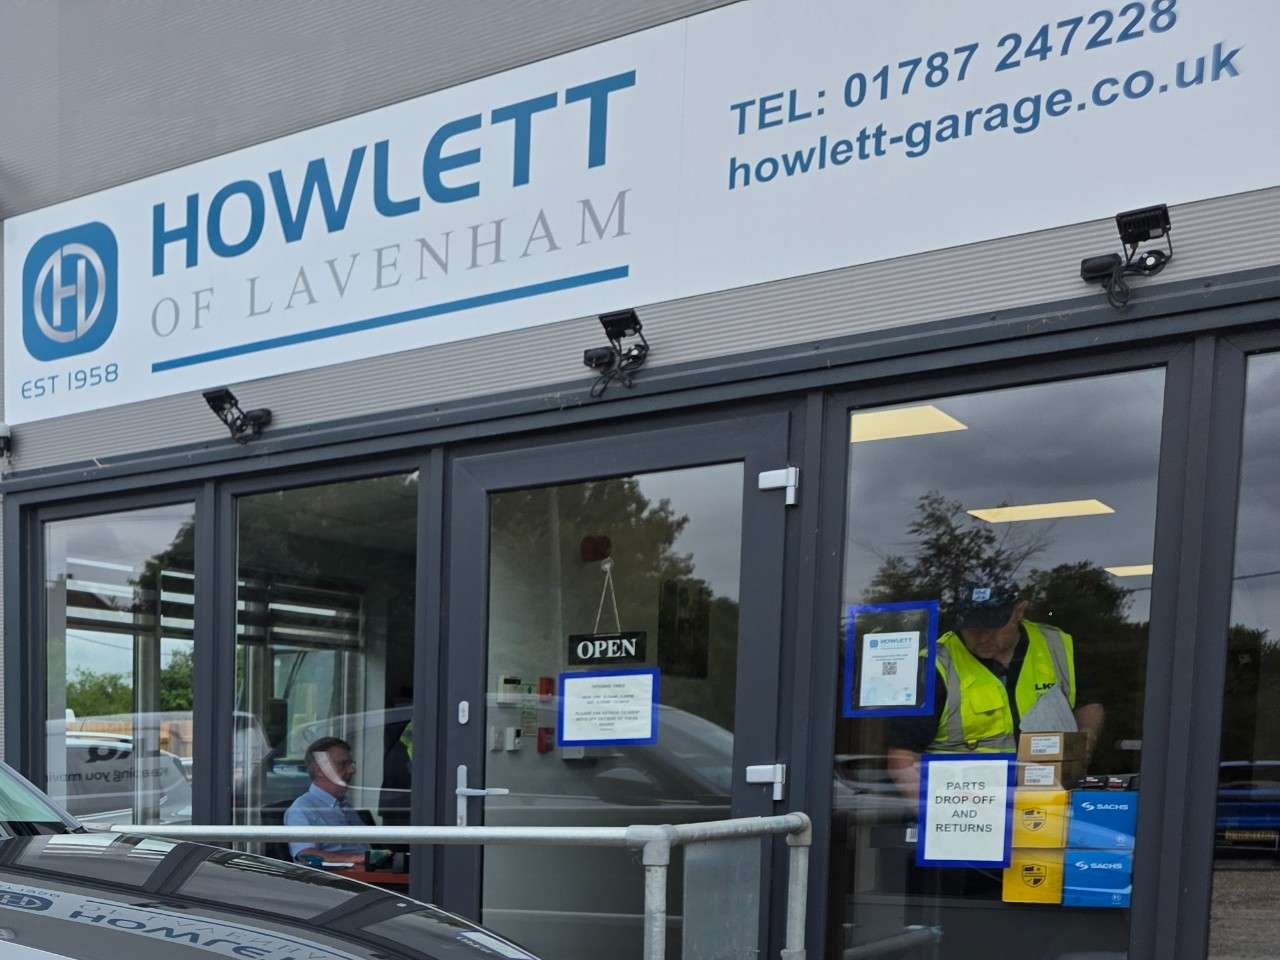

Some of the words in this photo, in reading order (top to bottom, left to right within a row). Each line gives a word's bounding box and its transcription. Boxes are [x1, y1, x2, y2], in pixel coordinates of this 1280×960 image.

[730, 90, 826, 136] TEL:
[843, 43, 979, 110] 01787
[994, 0, 1179, 73] 247228
[728, 41, 1245, 190] howlett-garage.co.uk
[151, 69, 636, 277] HOWLETT
[151, 287, 215, 338] OF
[246, 188, 633, 317] LAVENHAM
[22, 375, 59, 399] EST
[68, 363, 119, 391] 1958
[577, 639, 637, 659] OPEN
[946, 781, 986, 790] PARTS
[935, 796, 969, 804] DROP
[972, 795, 996, 804] OFF
[952, 810, 978, 818] AND
[1096, 803, 1129, 811] SACHS
[935, 823, 993, 832] RETURNS
[1090, 862, 1123, 870] SACHS
